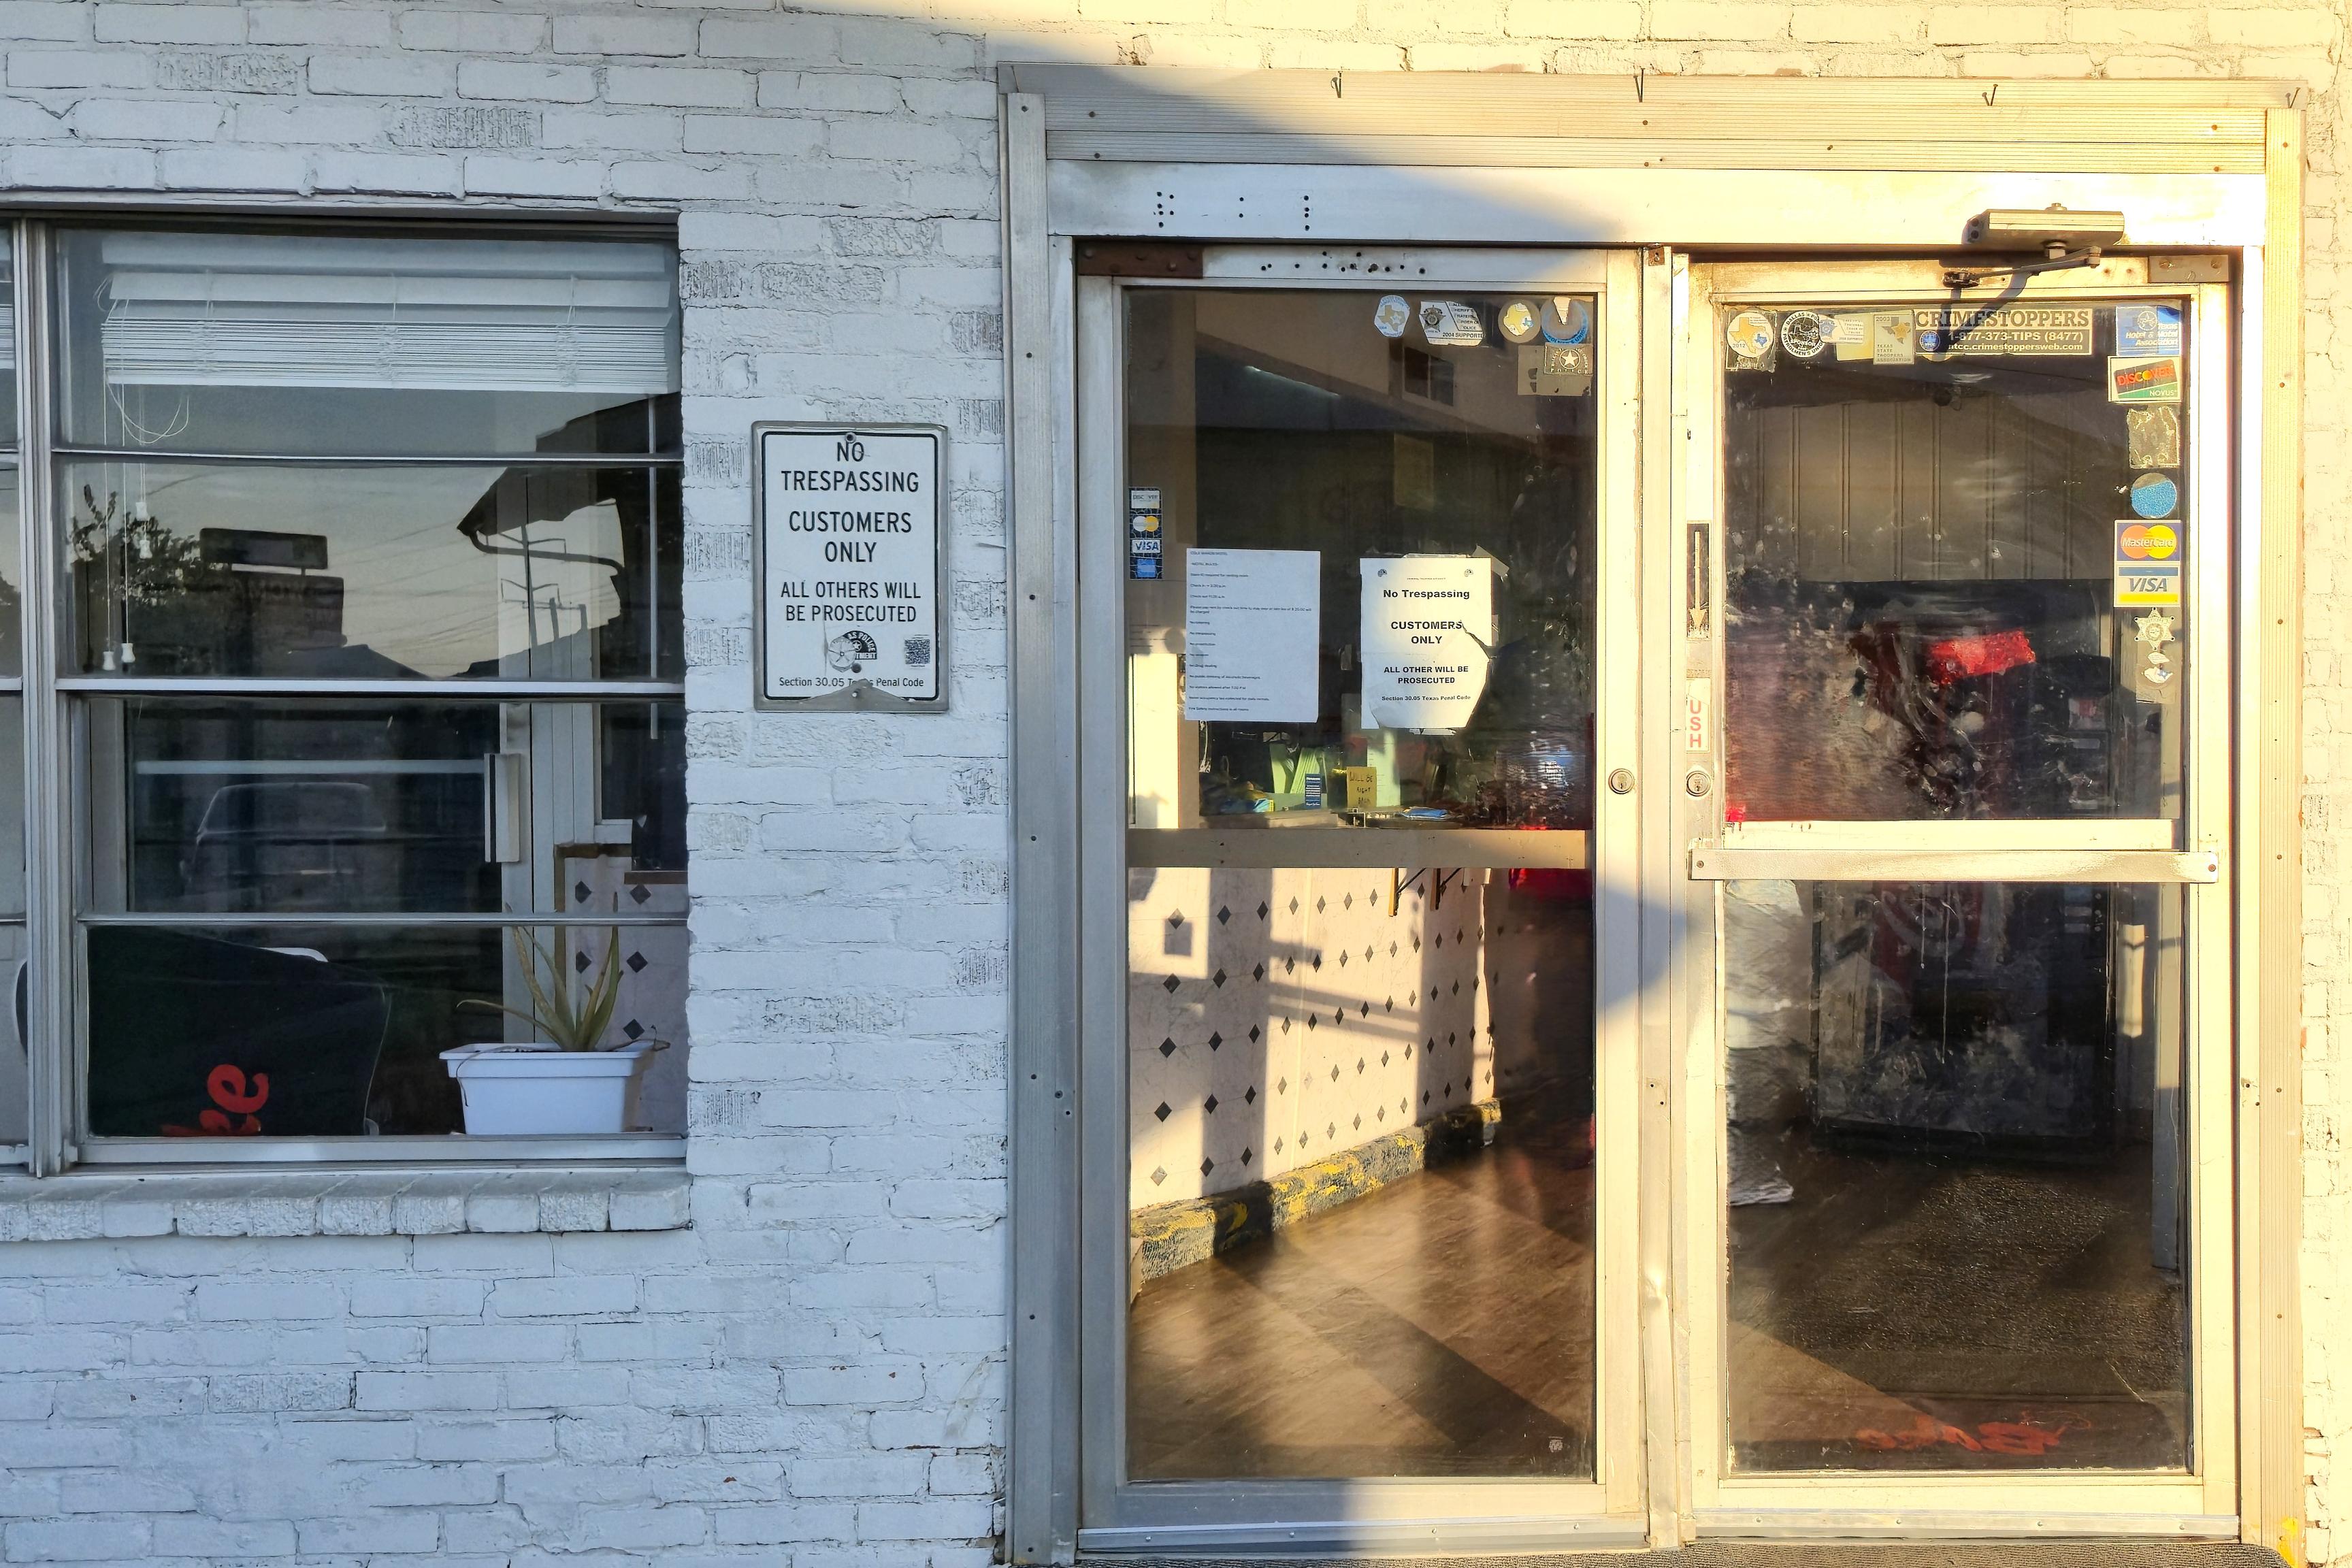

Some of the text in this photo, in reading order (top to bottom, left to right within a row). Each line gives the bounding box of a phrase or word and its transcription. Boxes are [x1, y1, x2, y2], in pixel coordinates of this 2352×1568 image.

[1786, 312, 1805, 325] DALLAS
[1915, 310, 2089, 327] CRIMESTOPPERS
[1948, 332, 2083, 342] 1-877-373-TIPS (8477)
[1948, 343, 2082, 352] ntcc.crimestoppersweb.com
[2117, 365, 2174, 386] DISCOVER
[836, 442, 864, 462] NO
[781, 471, 919, 493] TRESPASSING
[789, 511, 912, 533] CUSTOMERS
[1135, 540, 1159, 551] VISA
[2121, 538, 2174, 548] MasterCard
[825, 542, 877, 563] ONLY
[781, 581, 921, 599] ALL OTHERS WILL
[2129, 578, 2168, 592] VISA
[1384, 589, 1470, 600] No Trespassing
[785, 605, 917, 622] BE PROSECUTED
[1390, 621, 1463, 630] CUSTOMERS
[1411, 636, 1442, 644] ONLY
[779, 677, 812, 687] Section
[815, 677, 845, 687] 30.05
[876, 677, 900, 687] Penal
[902, 677, 924, 687] Code
[1690, 700, 1701, 748] USH
